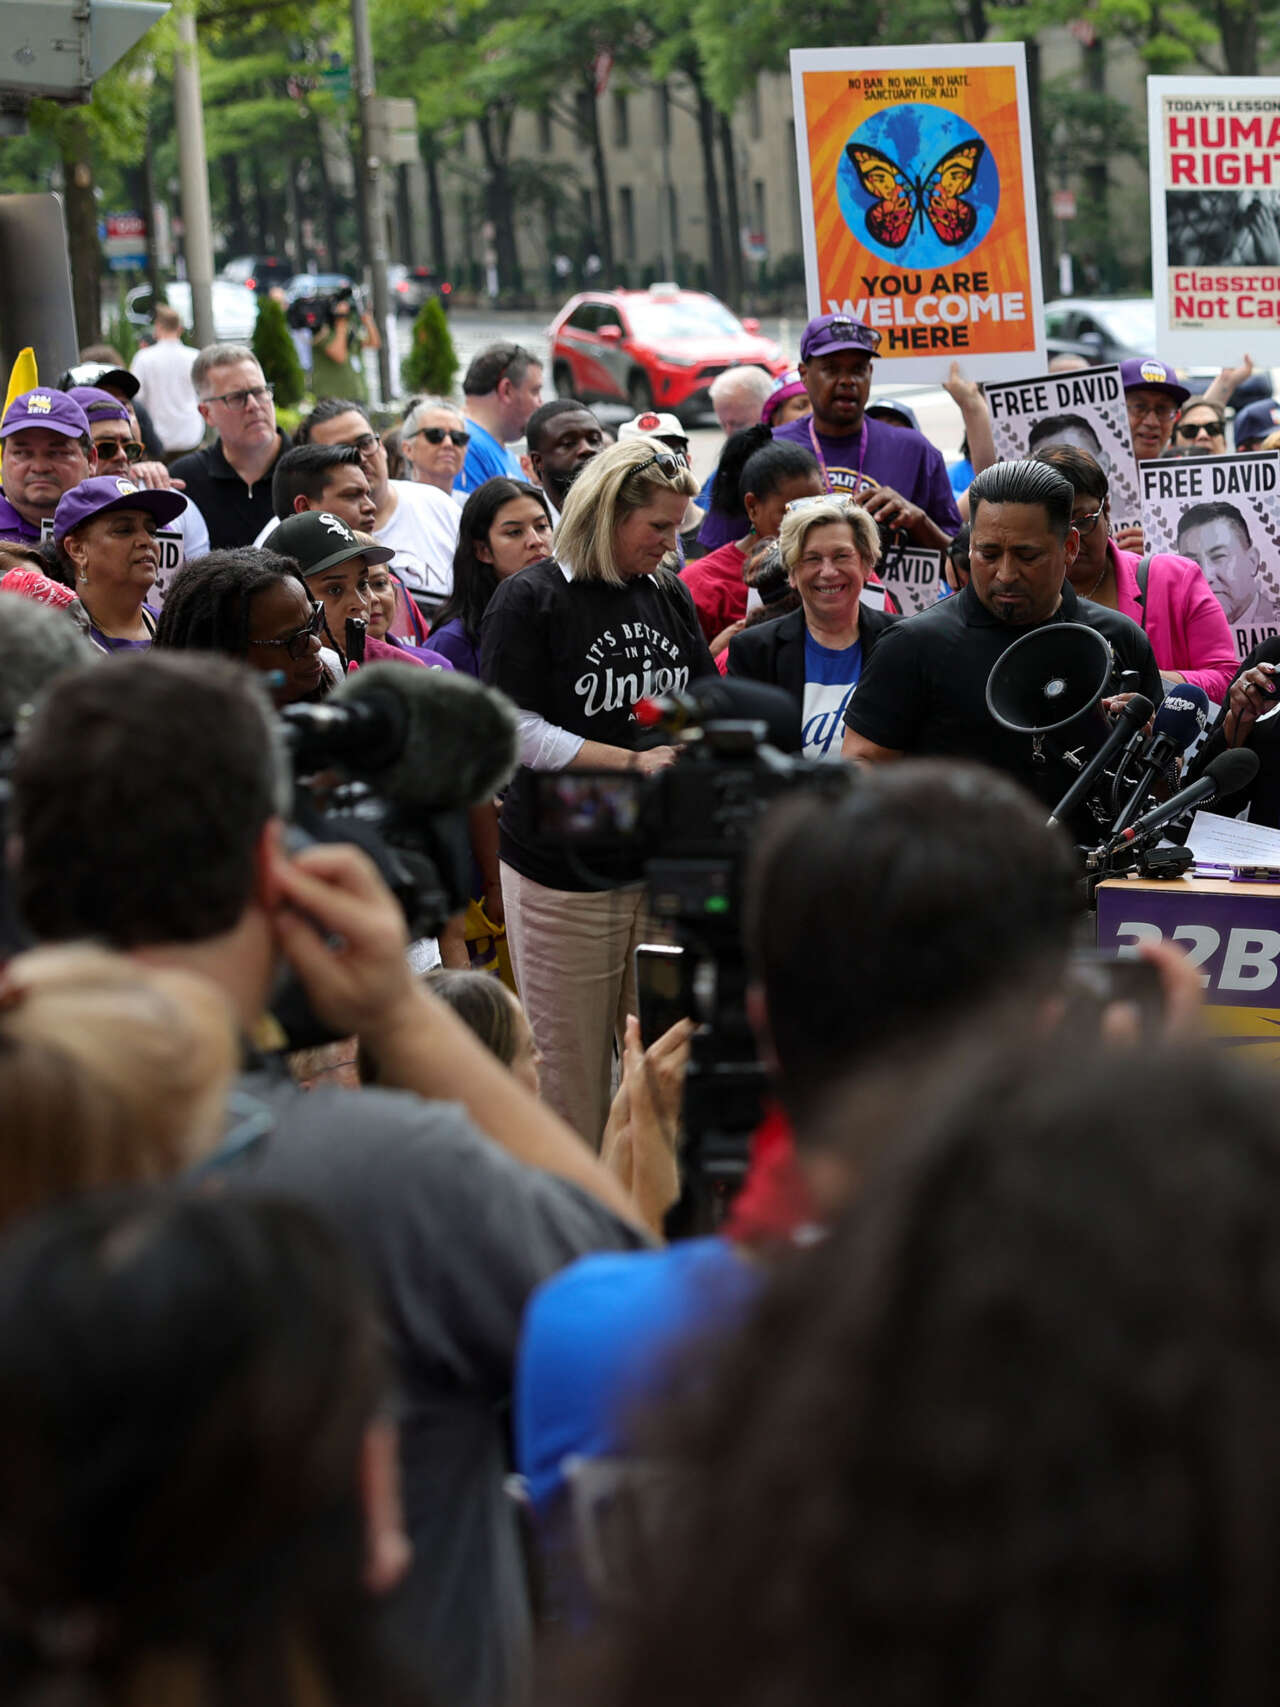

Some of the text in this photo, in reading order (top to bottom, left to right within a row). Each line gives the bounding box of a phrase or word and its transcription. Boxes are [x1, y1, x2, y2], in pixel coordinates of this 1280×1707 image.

[848, 79, 862, 89] NO
[888, 77, 901, 88] NO
[932, 76, 945, 87] NO
[864, 87, 958, 101] SANCTUARY FOR ALL!
[1167, 100, 1226, 113] TODAY'S
[861, 271, 989, 297] YOU ARE
[827, 291, 1026, 327] WELCOME
[1174, 295, 1229, 319] Not
[888, 325, 969, 350] HERE
[990, 375, 1120, 419] FREE DAVID
[1143, 462, 1277, 499] FREE DAVID
[585, 621, 680, 666] IT'S BETTER
[624, 645, 651, 659] IN A
[574, 659, 689, 717] Union
